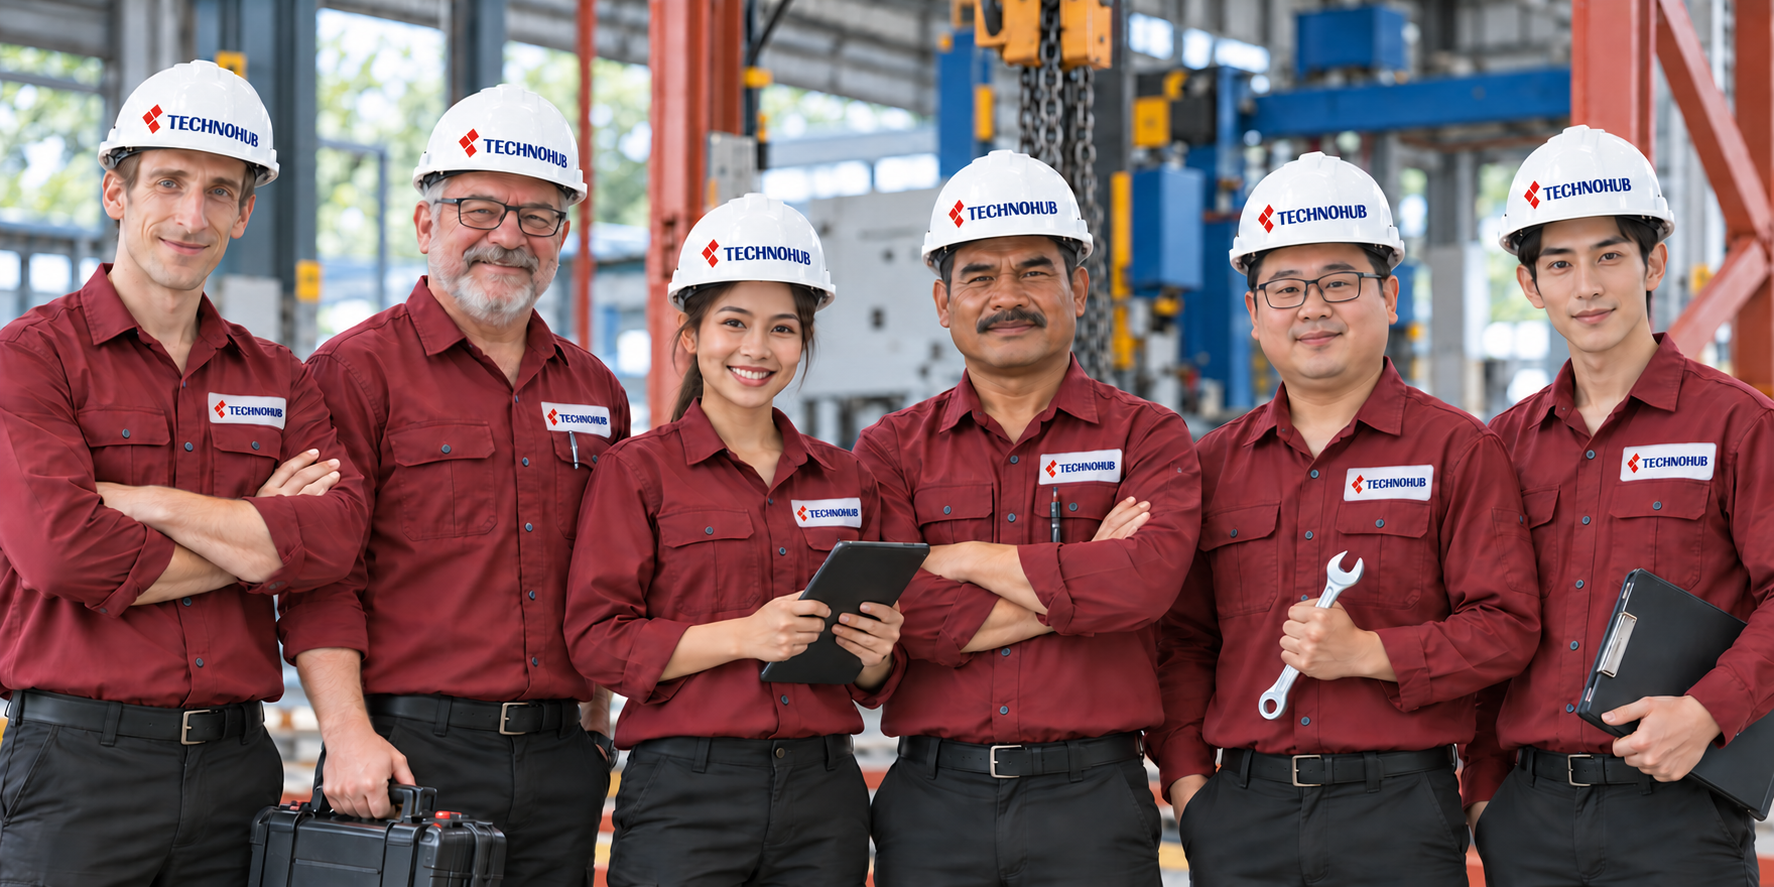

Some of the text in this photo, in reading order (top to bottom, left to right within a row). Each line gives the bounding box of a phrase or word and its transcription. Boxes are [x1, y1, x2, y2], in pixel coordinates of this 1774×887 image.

[168, 115, 258, 147] TECHNOHUB
[484, 139, 567, 168] TECHNOHUB
[1543, 178, 1631, 200] TECHNOHUB
[968, 201, 1057, 220] TECHNOHUB
[1277, 205, 1367, 225] TECHNOHUB
[724, 246, 811, 265] TECHNOHUB
[229, 406, 282, 417] TECHNOHUB
[559, 413, 608, 426] TECHNOHUB
[1060, 461, 1115, 473] TECHNOHUB
[1643, 456, 1707, 468] TECHNOHUB
[1367, 478, 1426, 489] TECHNOHUB
[809, 508, 859, 519] TECHNOHUB
